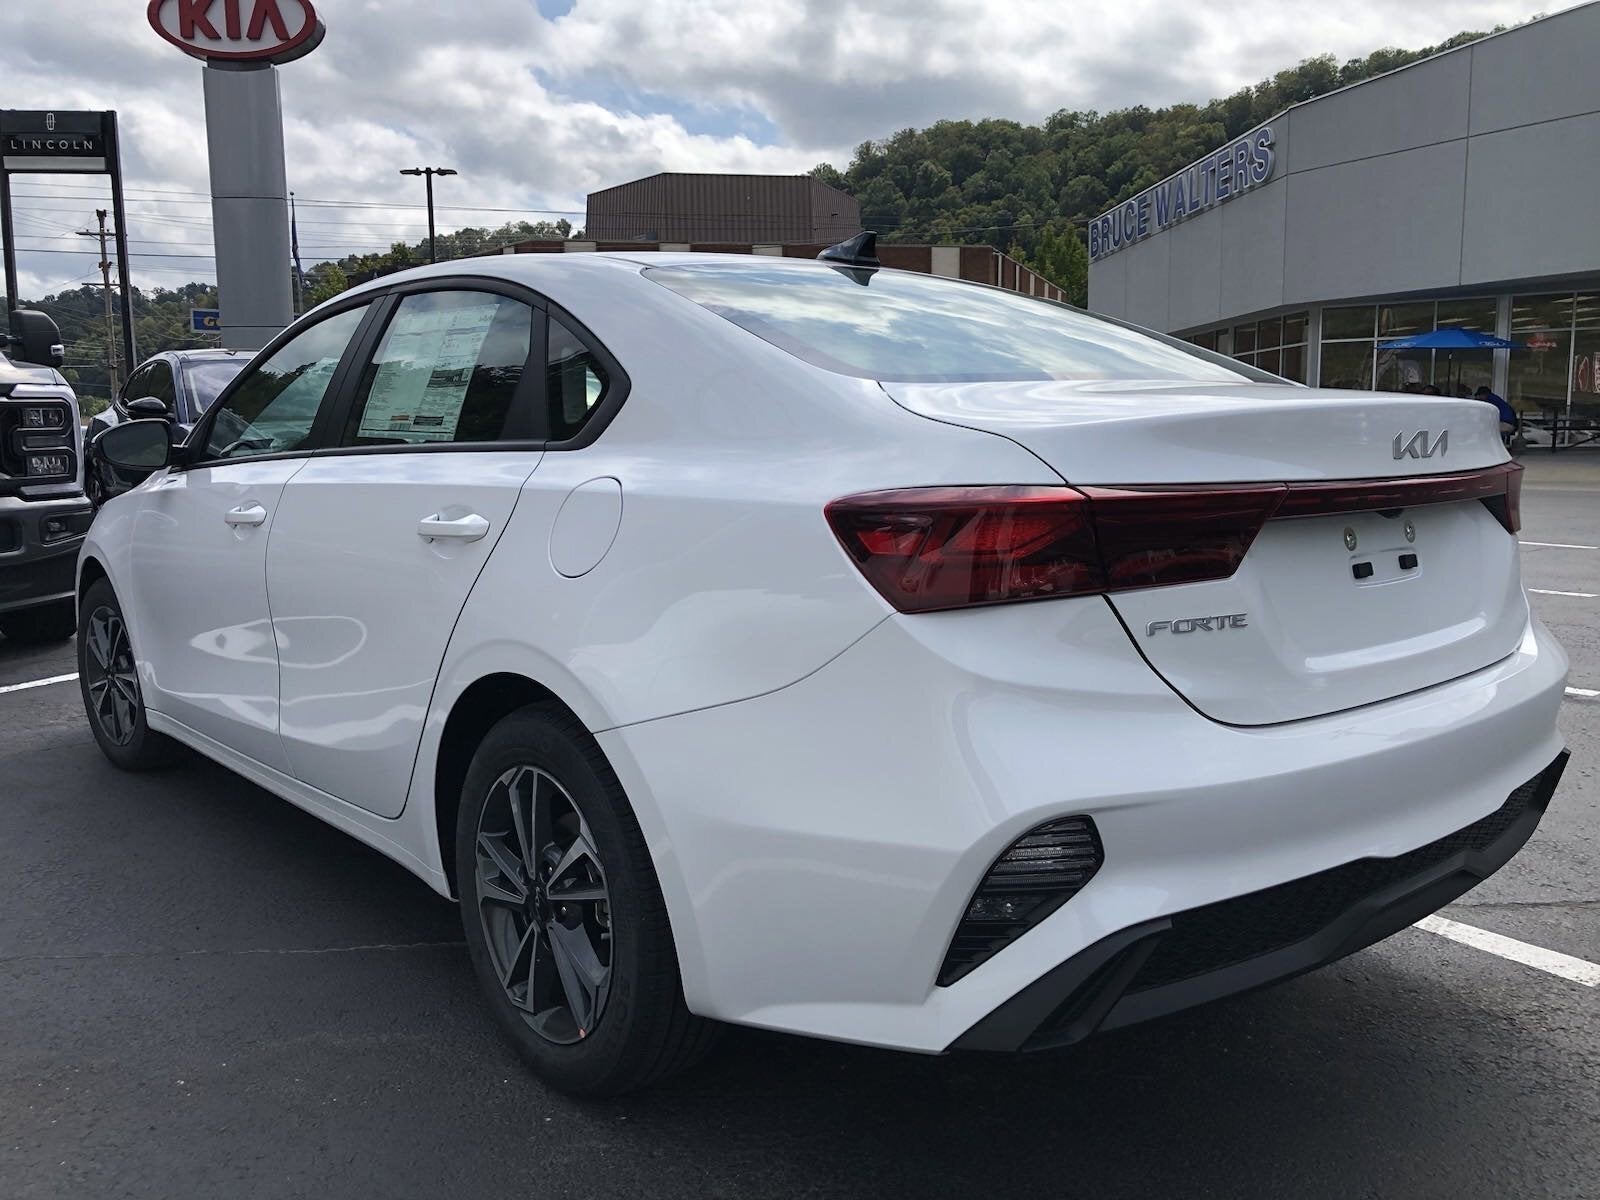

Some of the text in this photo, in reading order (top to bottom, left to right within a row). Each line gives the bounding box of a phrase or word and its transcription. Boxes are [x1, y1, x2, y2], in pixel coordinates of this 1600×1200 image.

[178, 0, 291, 40] KIA
[11, 139, 93, 150] LINCOLN
[1090, 127, 1274, 259] BRUCE WALTERS
[1393, 429, 1449, 460] KIA
[1146, 613, 1249, 637] FORTE
